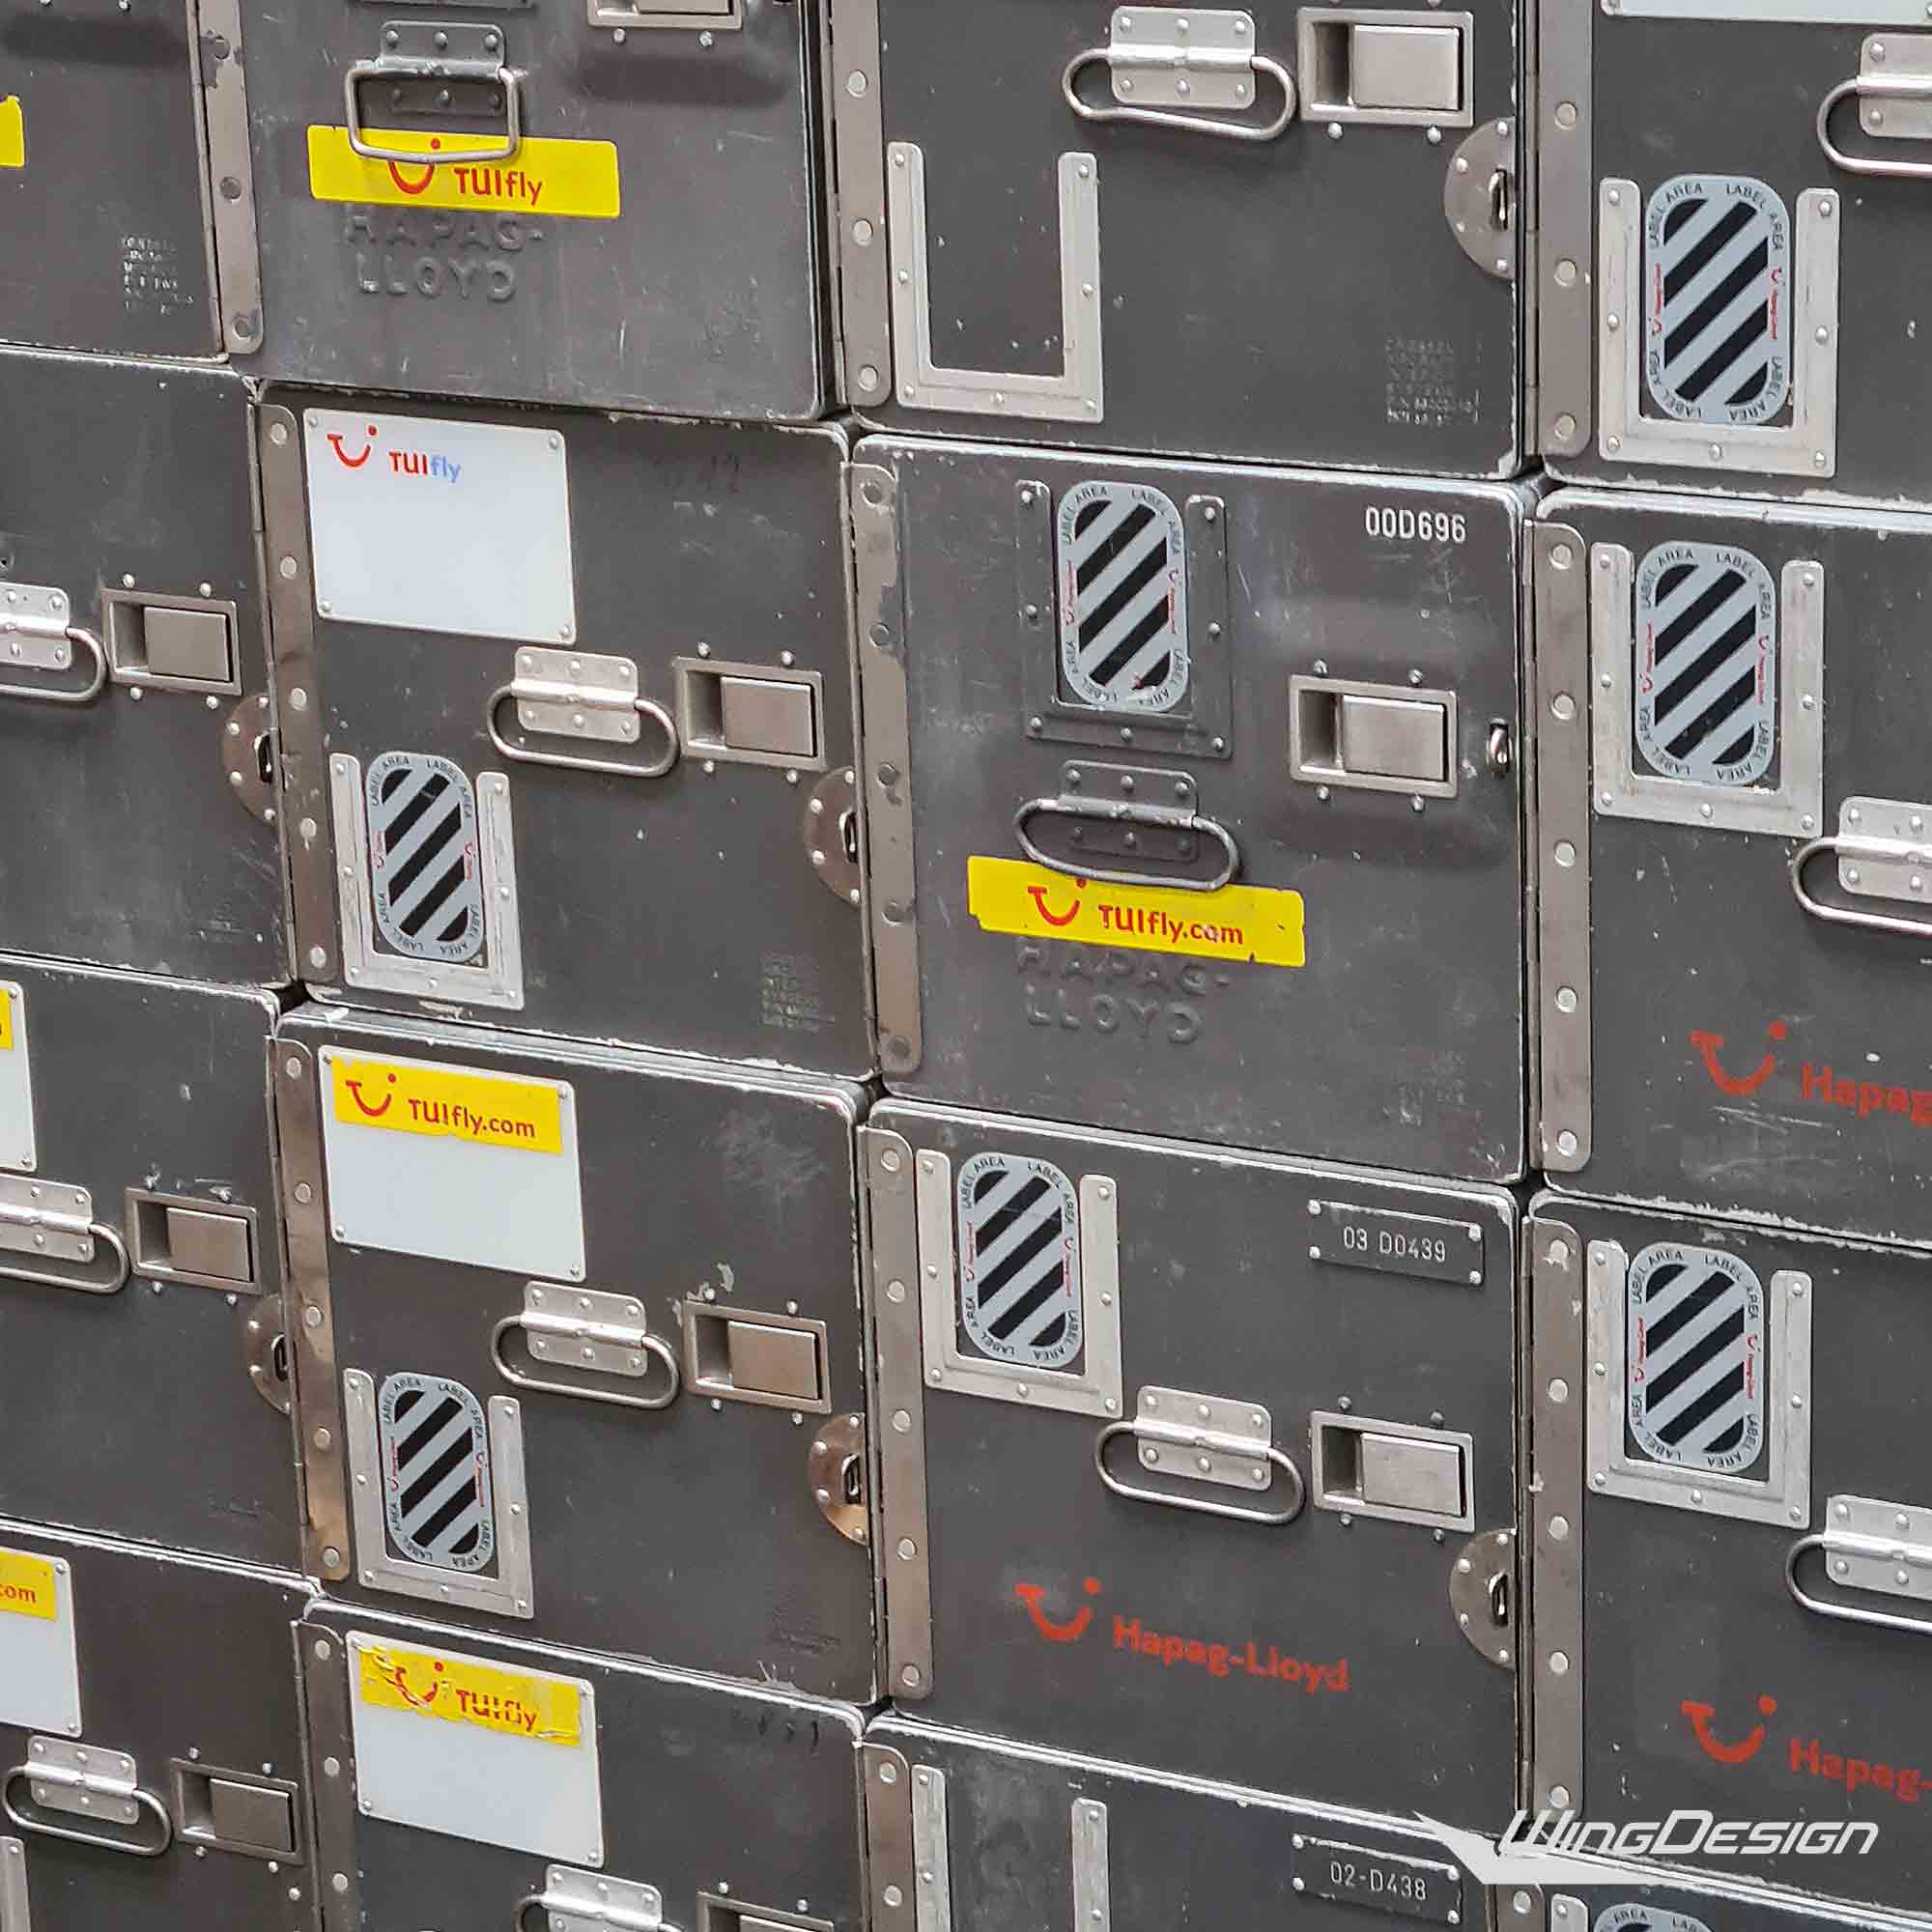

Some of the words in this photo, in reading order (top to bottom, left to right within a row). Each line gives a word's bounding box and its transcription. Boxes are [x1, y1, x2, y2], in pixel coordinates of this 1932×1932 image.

[453, 167, 543, 206] TUIfly
[1665, 183, 1702, 203] AREA
[1725, 184, 1767, 209] LABEL
[355, 250, 515, 302] LLOYD
[388, 451, 461, 483] TUIfly
[1366, 505, 1466, 543] 00D696
[1658, 549, 1693, 566] AREA
[1098, 903, 1244, 944] TUIfly.com
[1024, 981, 1204, 1045] LLOYD
[407, 1098, 535, 1138] TUIfly.com
[974, 1156, 1006, 1172] AREA
[1344, 1226, 1368, 1251] 03
[1648, 1250, 1684, 1266] AREA
[1704, 1254, 1744, 1282] LABEL
[394, 1377, 421, 1391] AREA
[1707, 1452, 1742, 1468] AREA
[1112, 1614, 1350, 1694] Hapag-Lloyd
